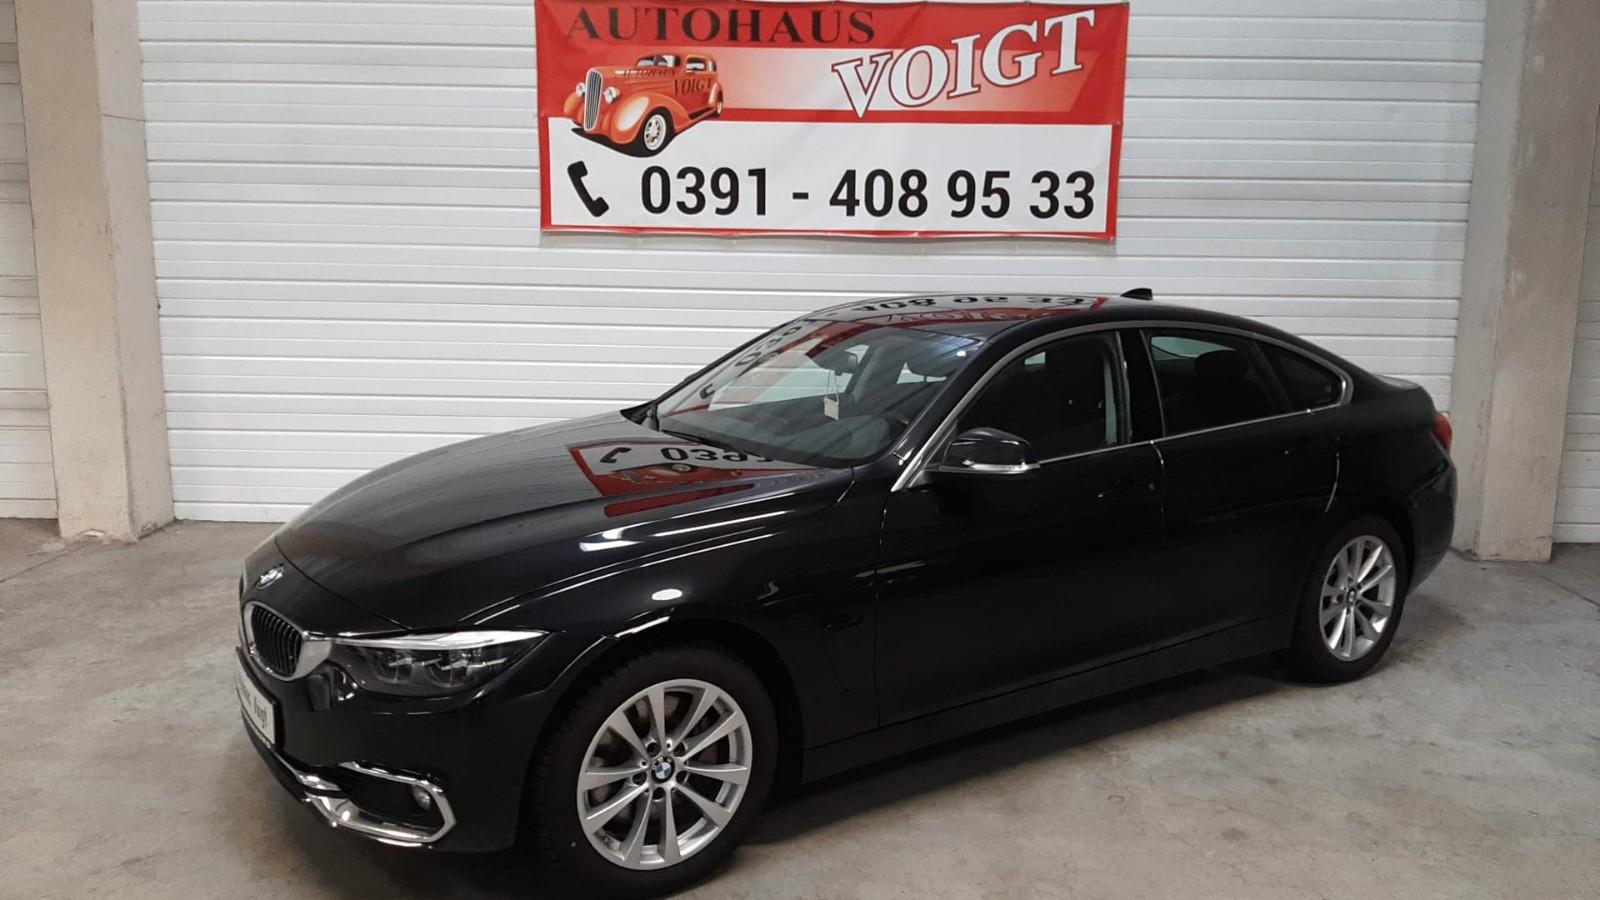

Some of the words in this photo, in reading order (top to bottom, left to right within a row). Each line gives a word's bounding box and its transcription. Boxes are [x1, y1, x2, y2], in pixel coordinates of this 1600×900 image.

[566, 7, 875, 44] AUTOHAUS
[831, 9, 1095, 118] VOIGT
[641, 165, 766, 216] 0391
[791, 191, 810, 201] -
[829, 168, 928, 218] 408
[947, 169, 1010, 219] 95
[1029, 170, 1095, 219] 33
